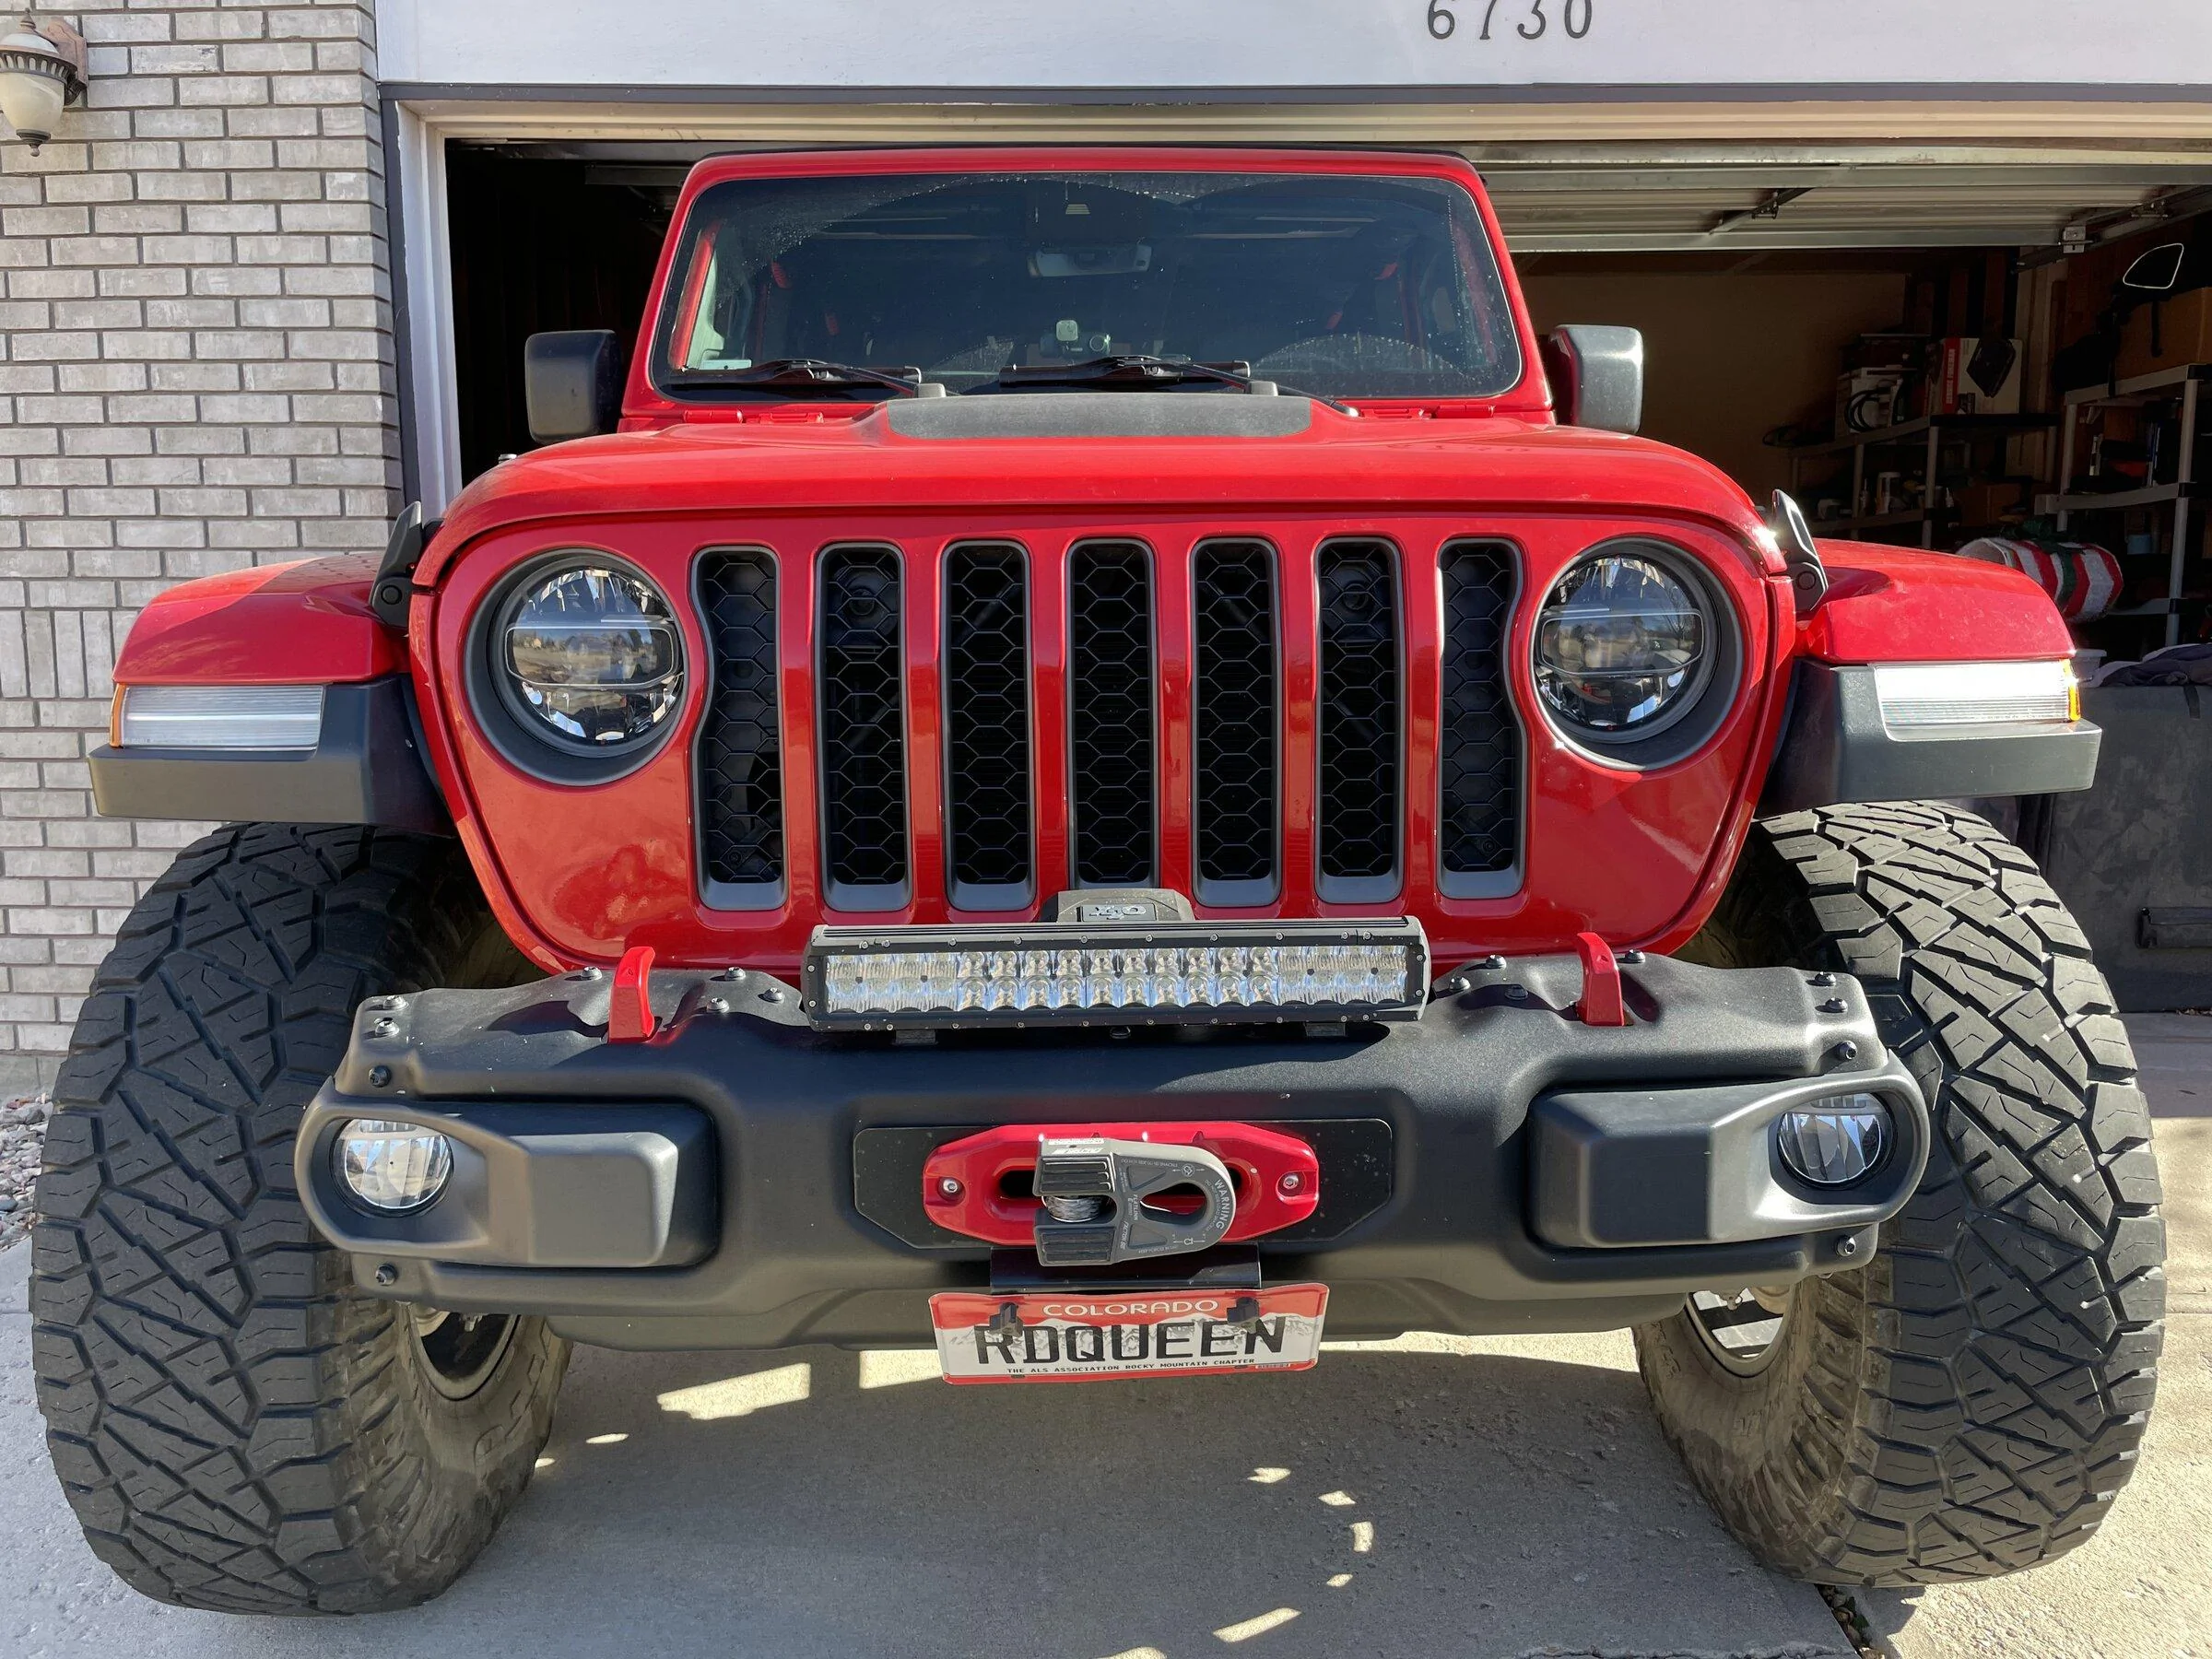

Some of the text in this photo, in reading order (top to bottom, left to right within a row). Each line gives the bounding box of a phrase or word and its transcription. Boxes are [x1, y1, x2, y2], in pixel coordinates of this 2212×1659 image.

[1428, 0, 1593, 40] 6730
[1215, 1179, 1230, 1230] WARNING
[1042, 1300, 1218, 1316] COLORADO
[974, 1316, 1286, 1364] RDQUEEN
